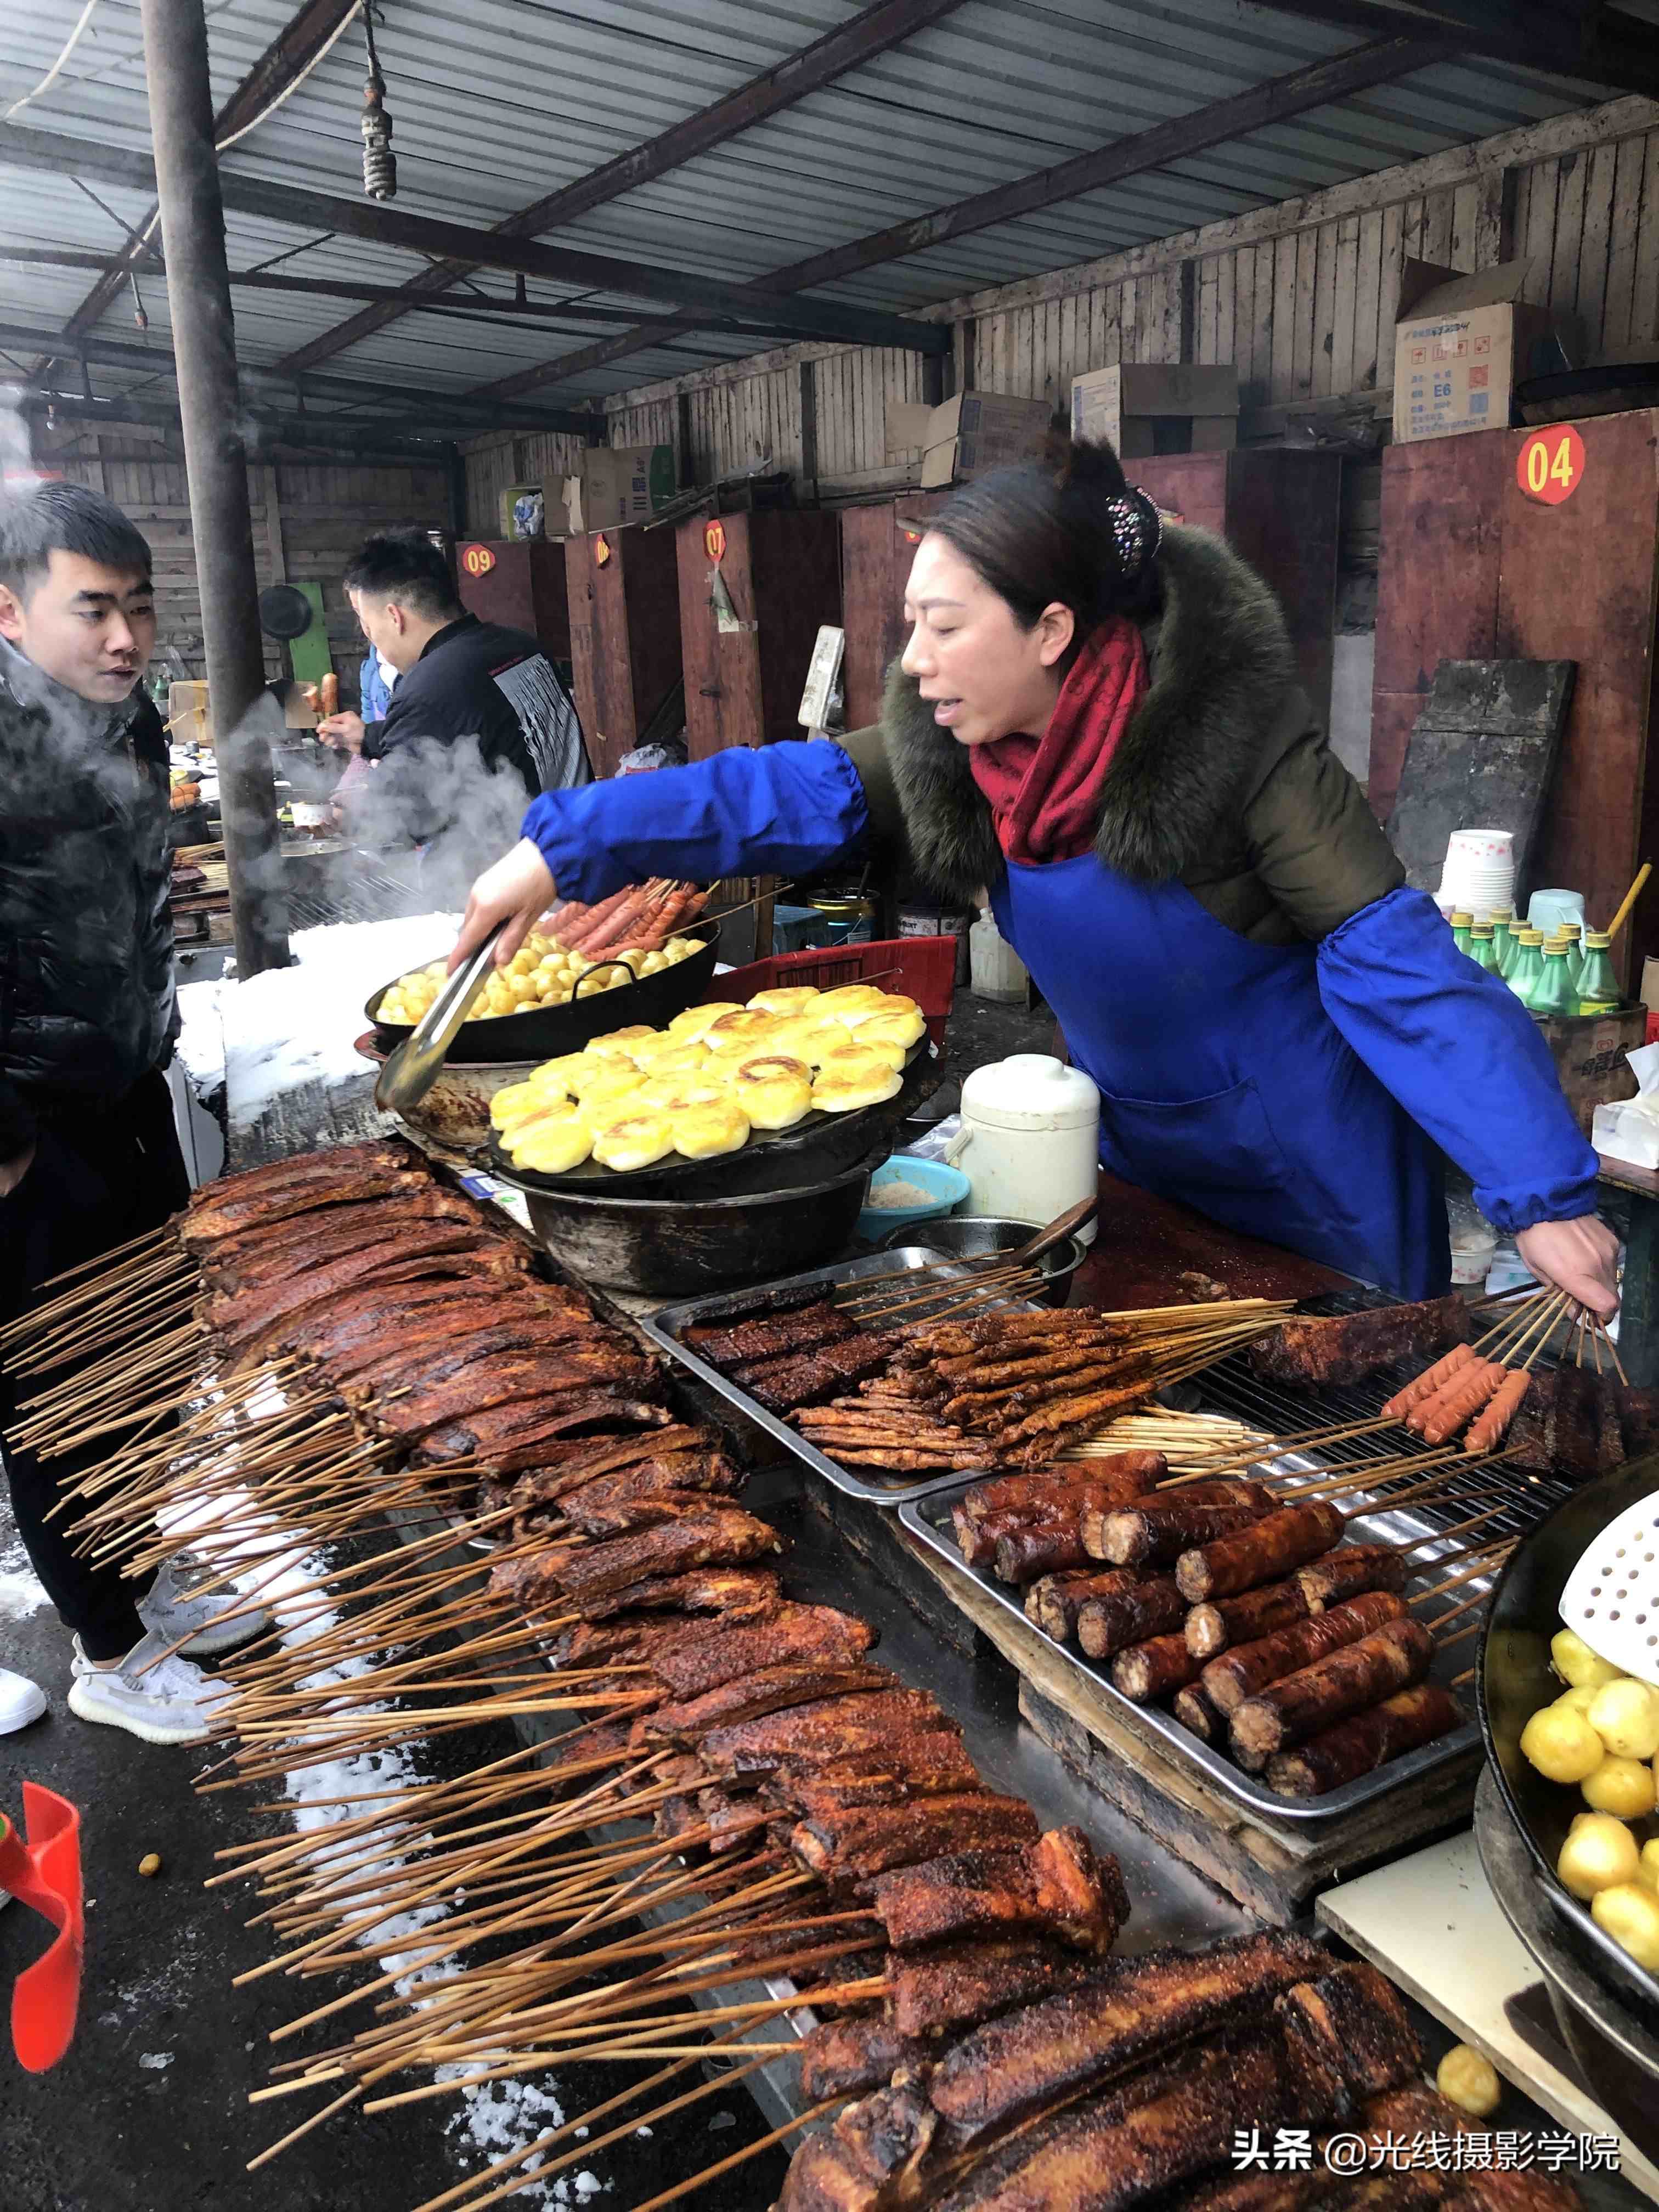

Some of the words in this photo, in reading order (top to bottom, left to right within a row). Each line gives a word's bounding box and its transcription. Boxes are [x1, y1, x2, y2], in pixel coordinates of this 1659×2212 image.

[1434, 383, 1452, 397] E6
[1527, 437, 1574, 492] 04
[706, 526, 723, 556] 07
[467, 550, 490, 572] 09
